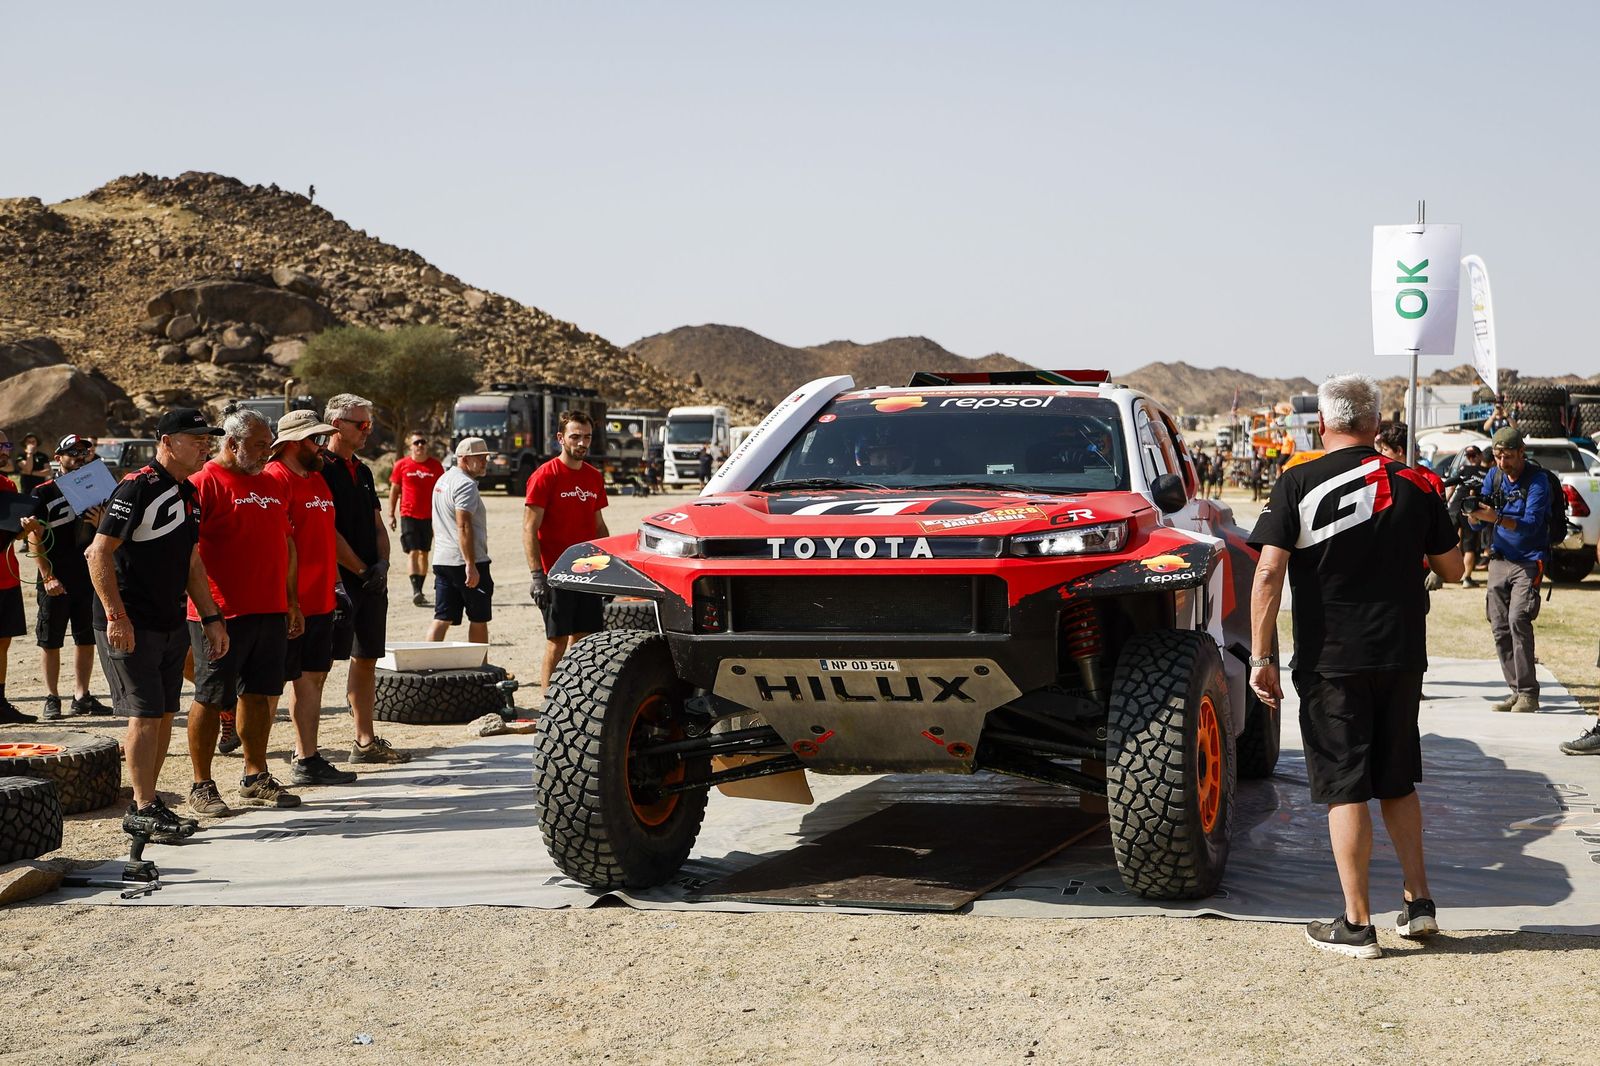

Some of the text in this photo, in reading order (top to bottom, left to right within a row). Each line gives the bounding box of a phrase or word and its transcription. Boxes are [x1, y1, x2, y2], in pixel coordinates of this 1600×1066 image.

[1395, 259, 1429, 320] OK
[939, 396, 1054, 410] repsol
[1050, 508, 1097, 526] GR
[766, 536, 934, 560] TOYOTA
[551, 573, 598, 583] repsol
[1144, 572, 1196, 584] repsol
[831, 660, 848, 670] NP
[870, 661, 895, 670] 504
[754, 676, 977, 702] HILUX
